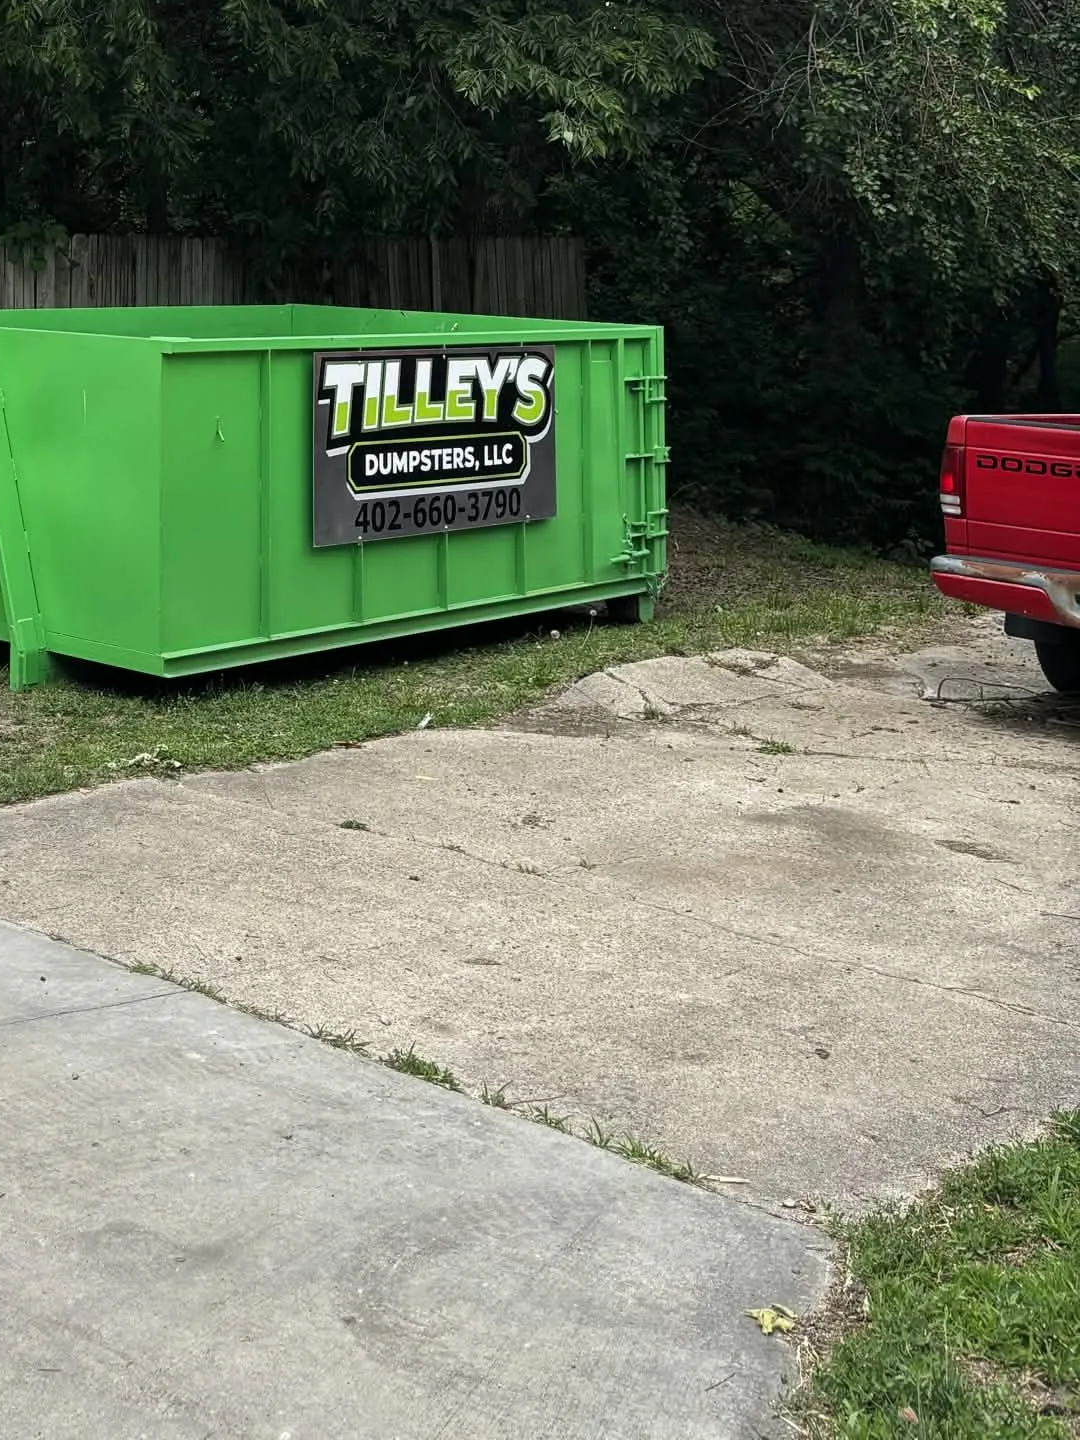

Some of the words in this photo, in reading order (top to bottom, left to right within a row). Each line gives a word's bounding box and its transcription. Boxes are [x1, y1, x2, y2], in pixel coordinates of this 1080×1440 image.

[324, 357, 548, 437] TILLEY'S
[365, 447, 480, 477] DUMPSTERS,
[484, 443, 513, 466] LLC
[976, 454, 1080, 478] DODG
[354, 488, 521, 533] 402-660-3790
